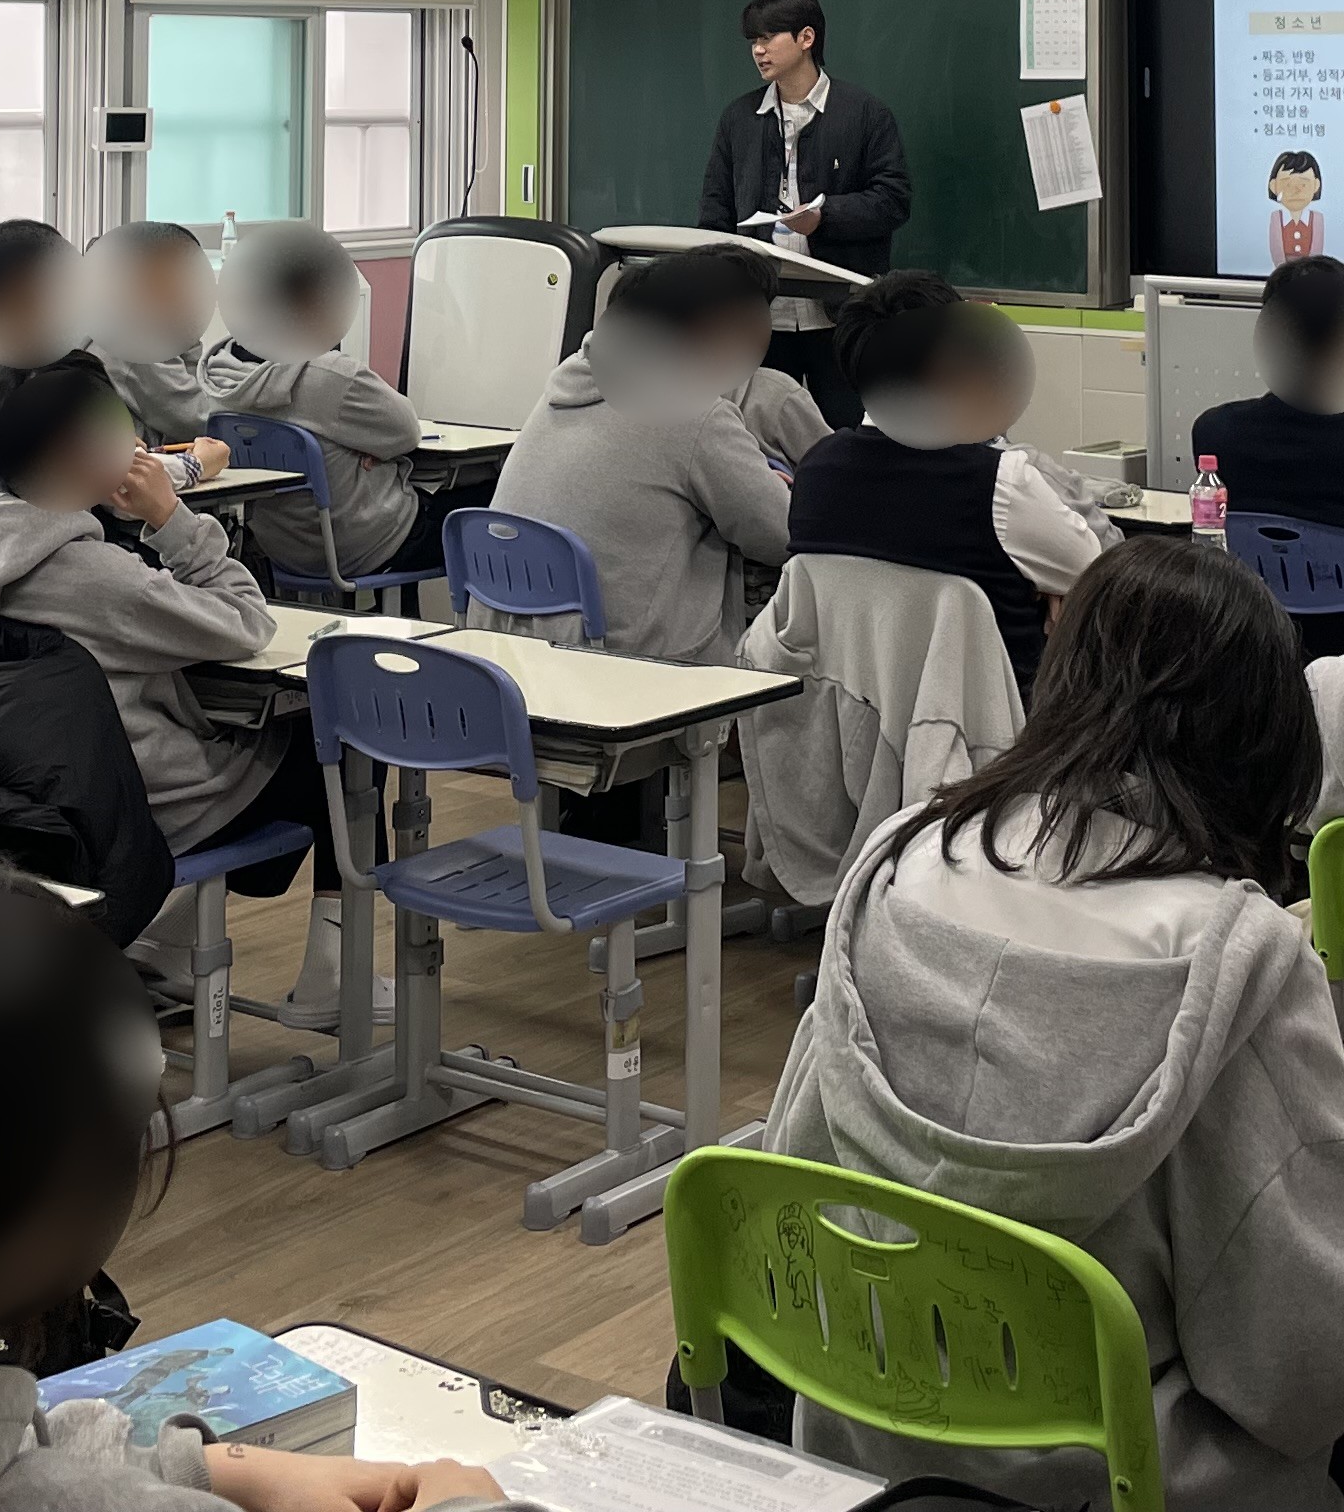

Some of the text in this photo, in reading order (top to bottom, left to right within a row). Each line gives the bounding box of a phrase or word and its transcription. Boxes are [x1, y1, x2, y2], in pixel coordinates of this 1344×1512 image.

[1291, 50, 1316, 65] 반항
[1261, 68, 1312, 83] 등교거부,
[1262, 87, 1286, 101] 여러
[1290, 87, 1314, 101] 가지
[1262, 104, 1310, 119] 약물남용
[1263, 122, 1326, 138] 청소년 비행
